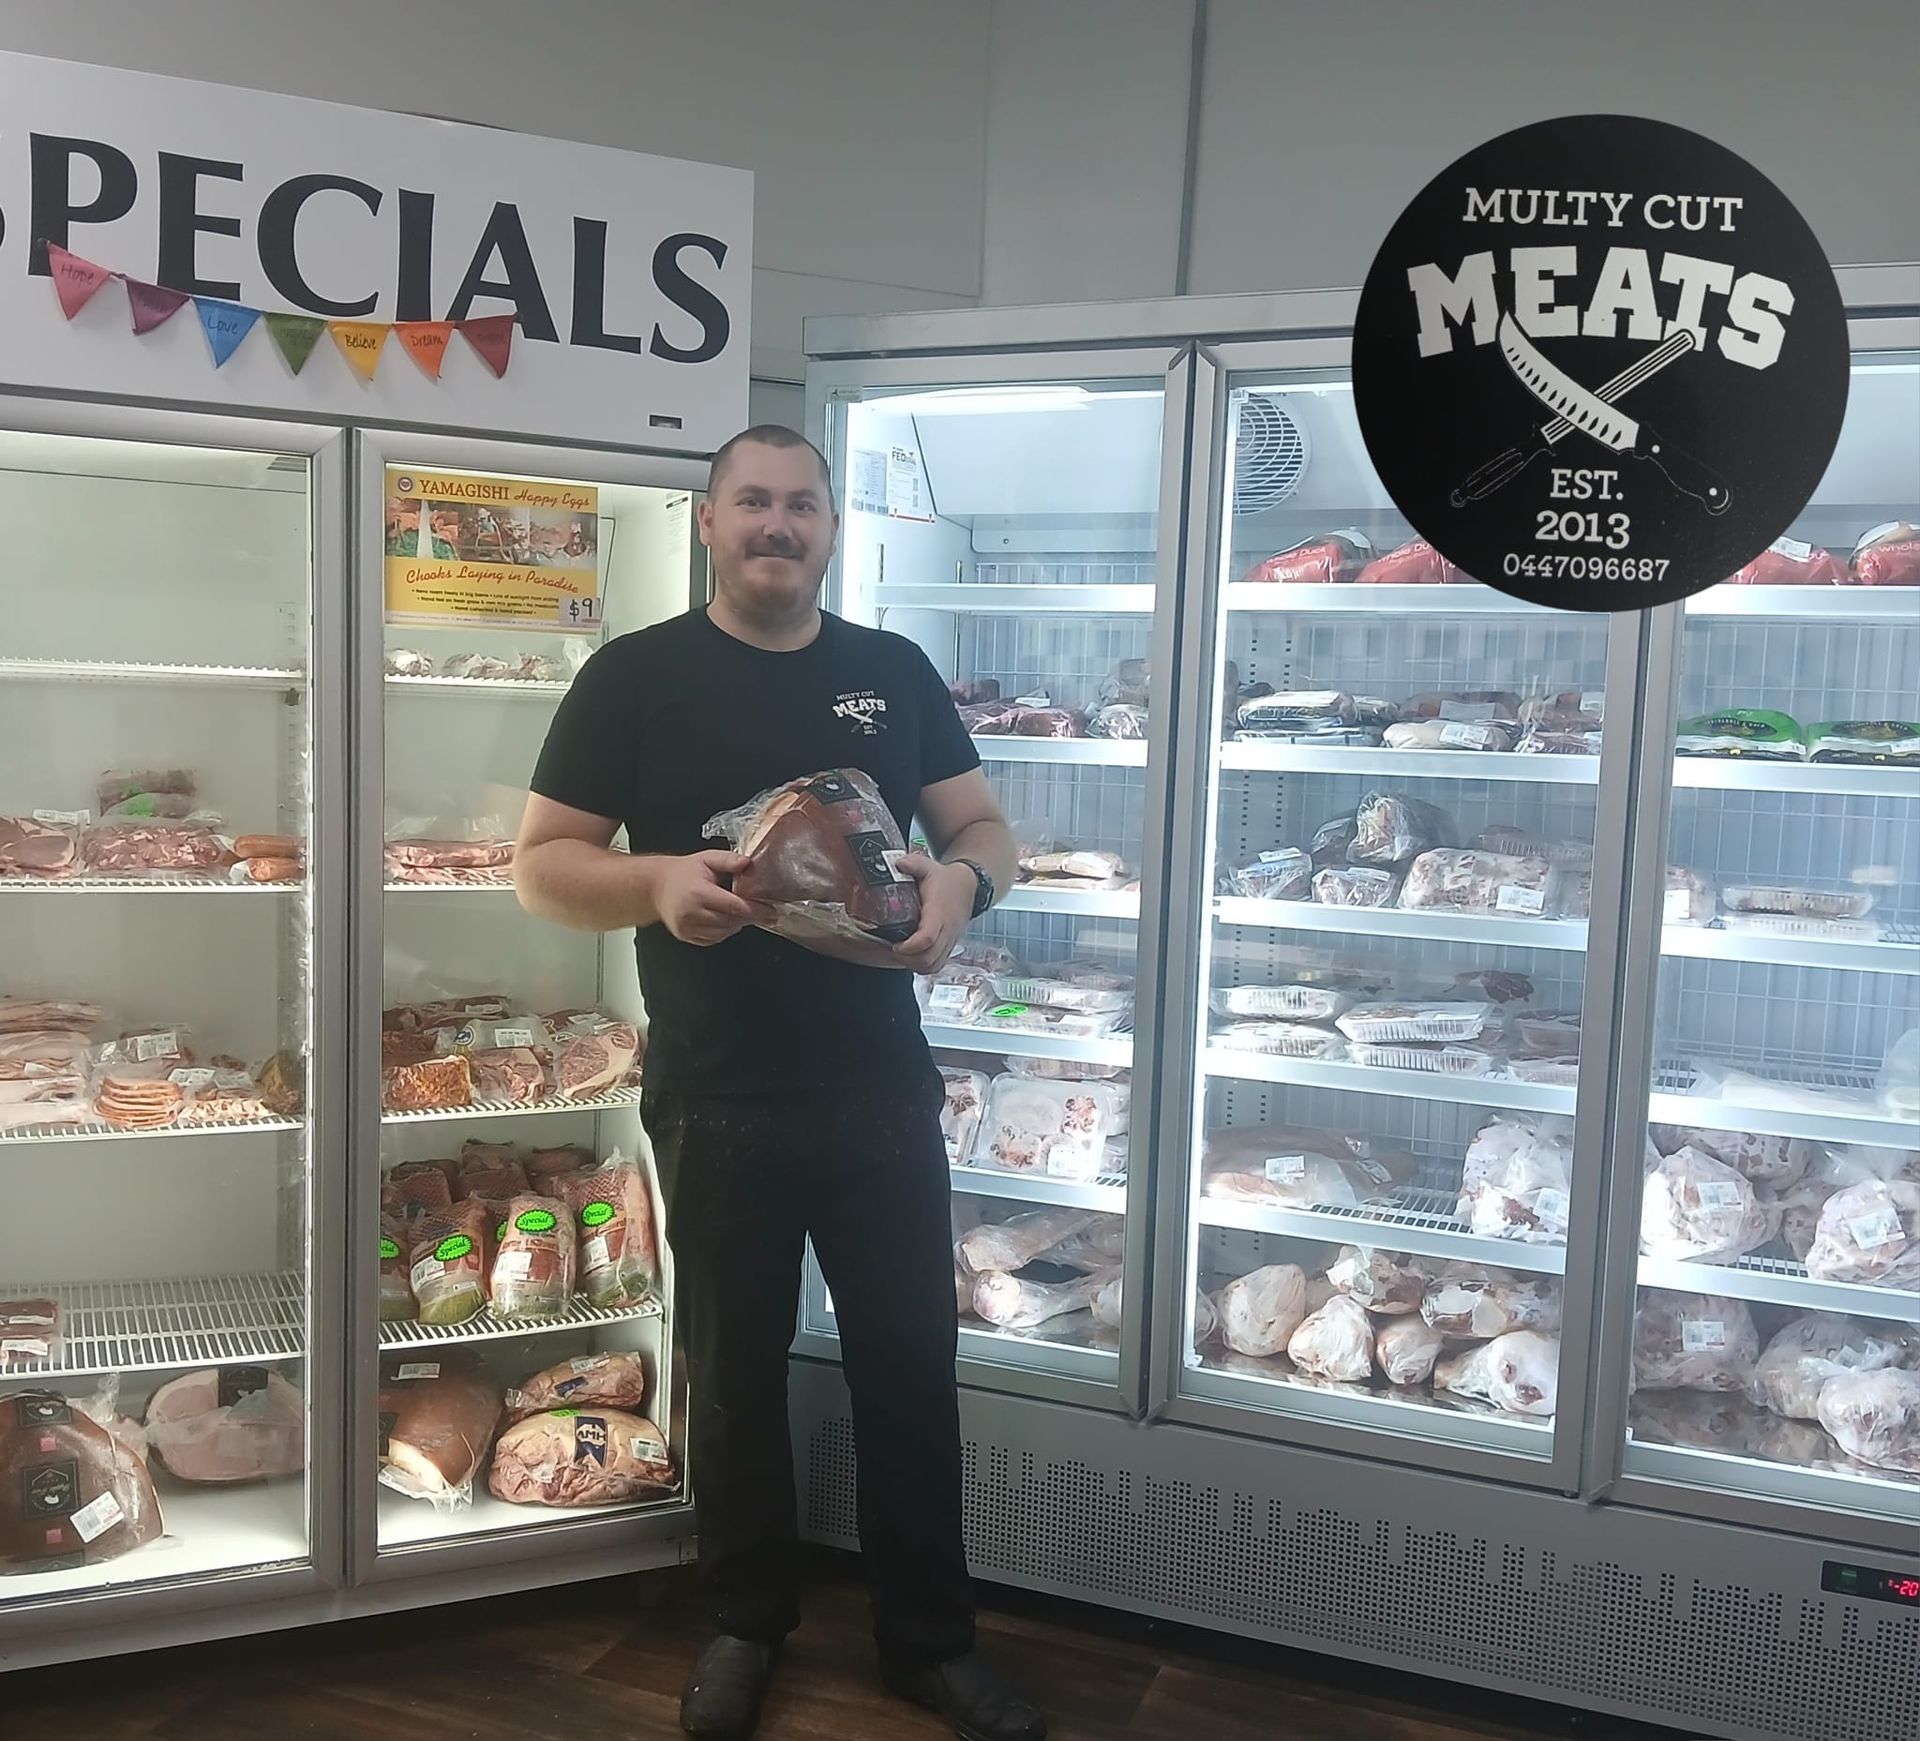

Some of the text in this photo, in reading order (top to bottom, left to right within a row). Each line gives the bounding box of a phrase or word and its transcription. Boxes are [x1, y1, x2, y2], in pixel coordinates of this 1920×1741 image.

[0, 131, 731, 364] PECIALS
[60, 263, 95, 285] Hope
[207, 316, 238, 335] Love
[345, 334, 377, 350] Believe
[411, 334, 443, 346] Dream
[419, 479, 590, 508] YAMAGISHI Happy Eggs
[406, 565, 579, 594] Chooks Laying in Paradise
[569, 597, 593, 622] $9
[832, 698, 887, 718] MEATS
[520, 1215, 550, 1228] Special
[585, 1208, 608, 1221] Special
[440, 1239, 466, 1257] Special
[1894, 1580, 1919, 1597] -20
